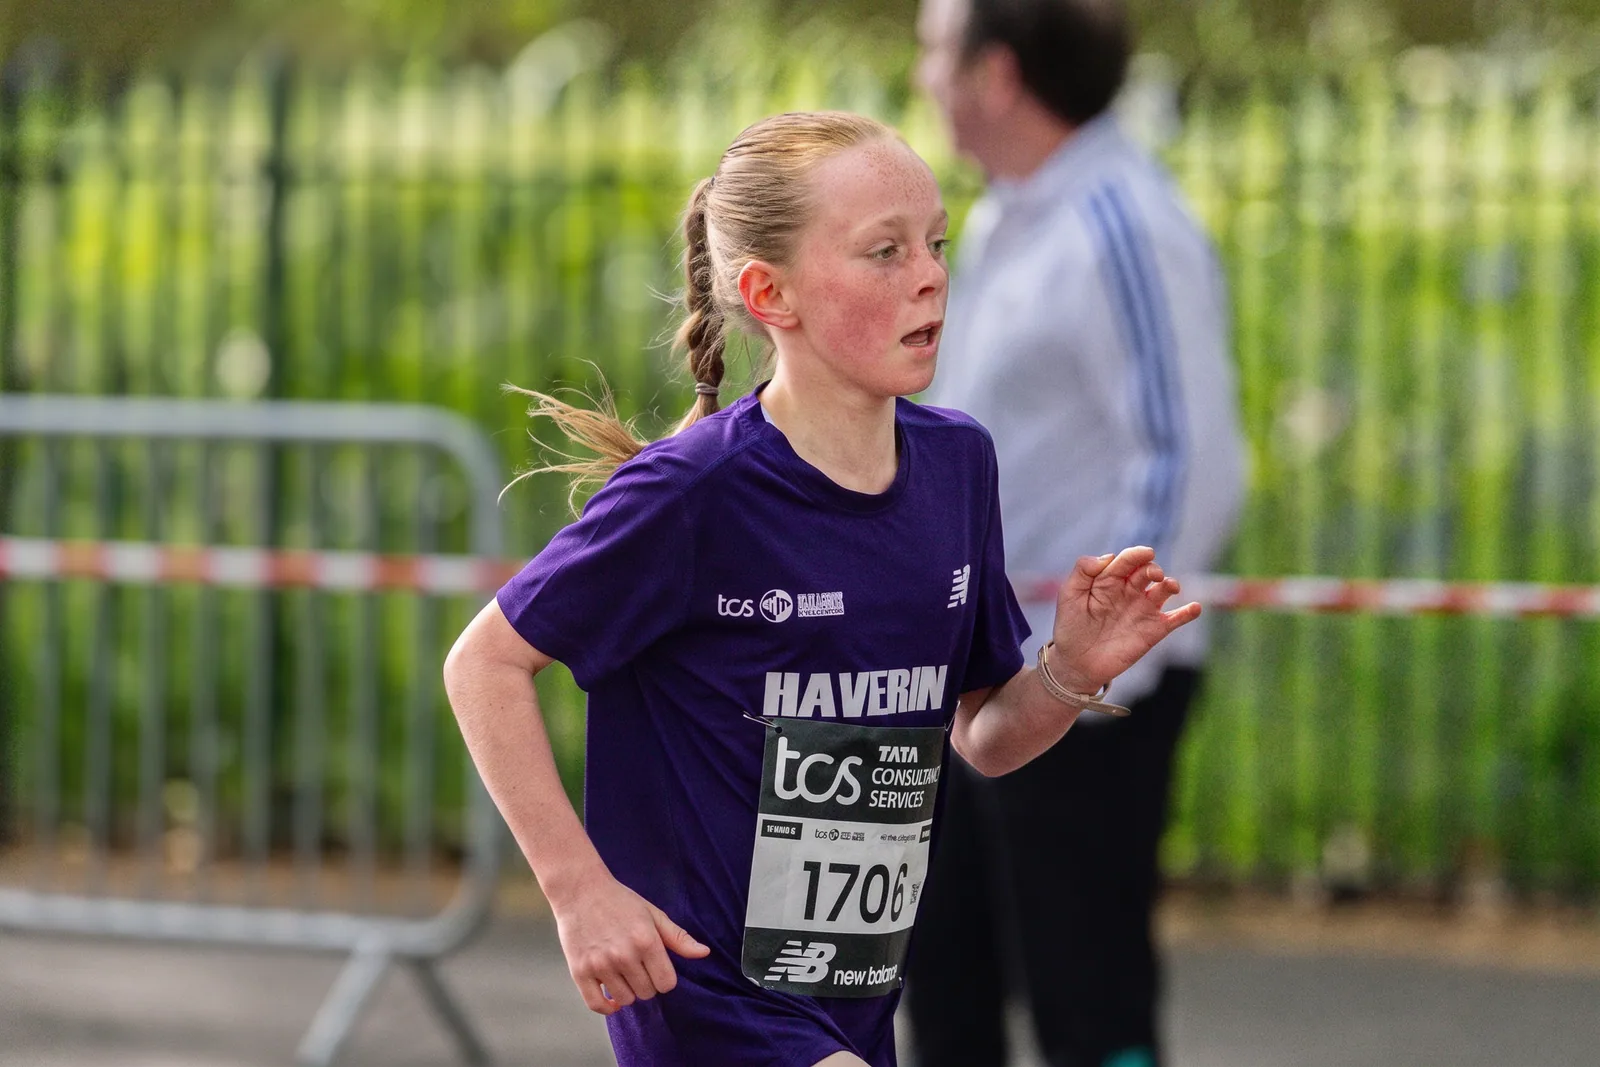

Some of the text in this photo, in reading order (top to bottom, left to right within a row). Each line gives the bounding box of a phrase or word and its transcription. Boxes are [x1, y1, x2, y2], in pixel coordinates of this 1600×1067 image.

[718, 594, 754, 617] tcs
[763, 665, 948, 717] HAVERIN
[879, 746, 918, 763] TATA
[774, 736, 863, 805] tcs
[869, 790, 924, 808] SERVICES
[815, 828, 828, 839] tcs
[803, 861, 908, 923] 1706
[833, 969, 867, 986] new
